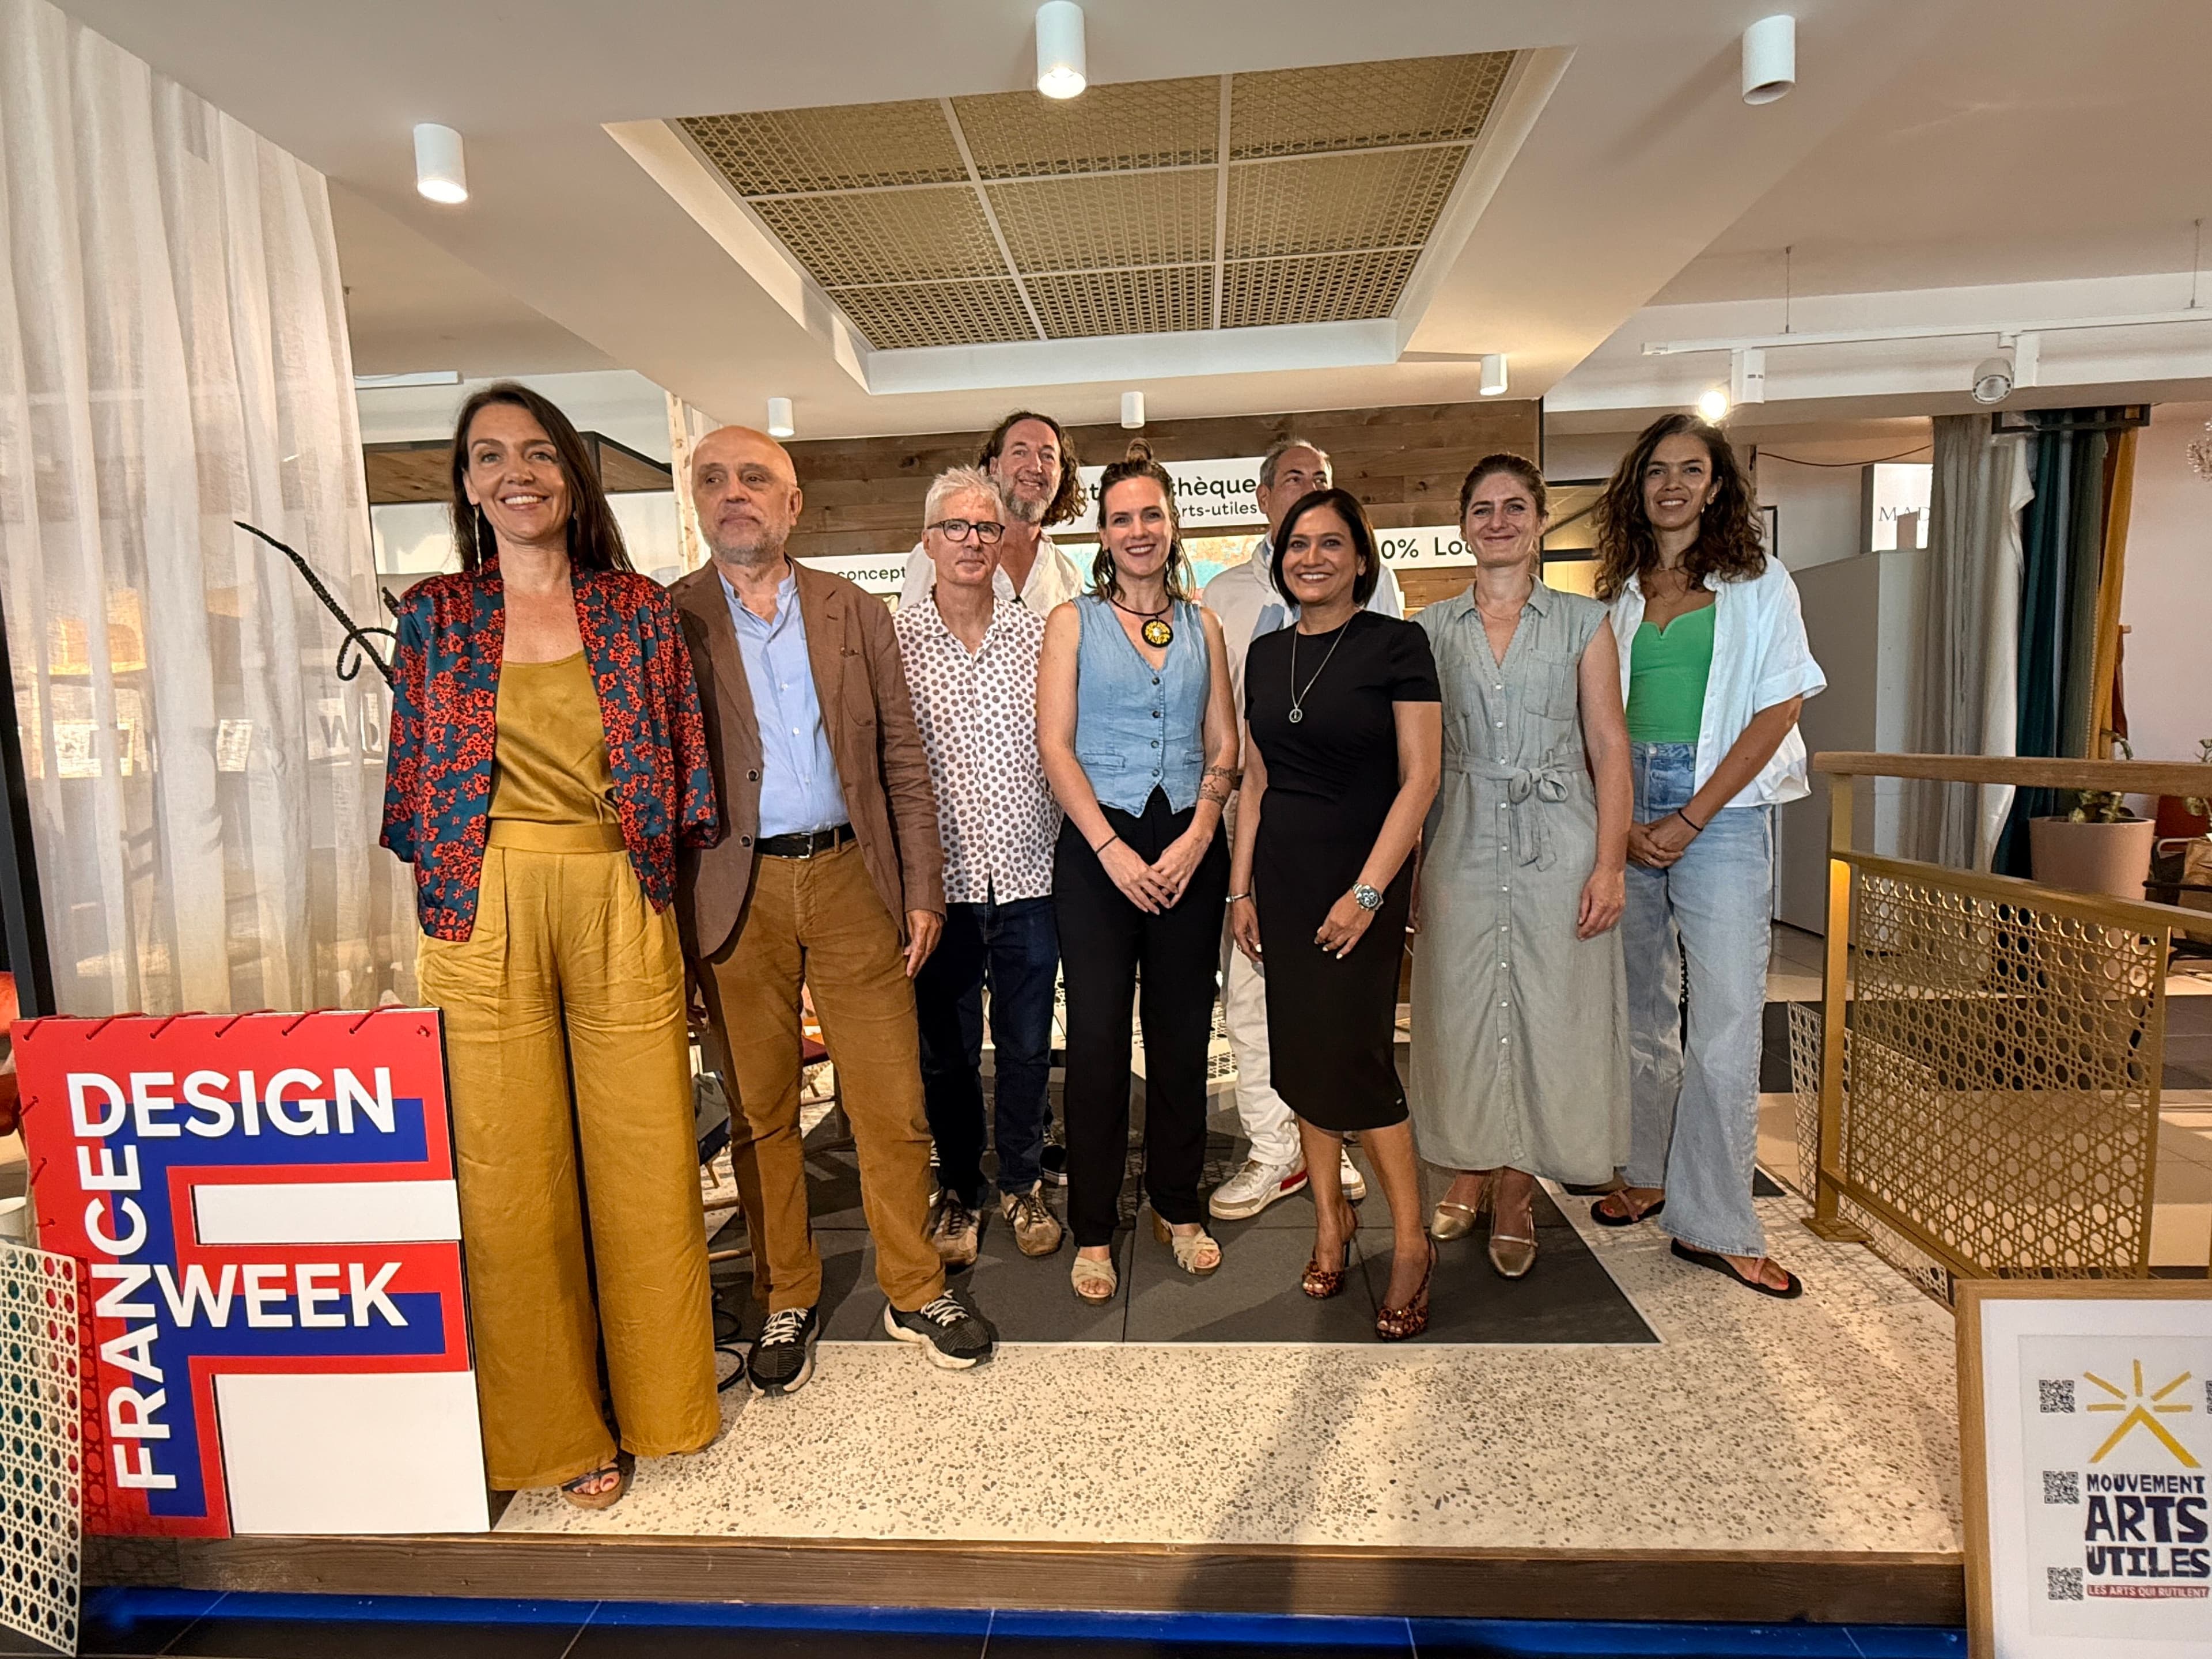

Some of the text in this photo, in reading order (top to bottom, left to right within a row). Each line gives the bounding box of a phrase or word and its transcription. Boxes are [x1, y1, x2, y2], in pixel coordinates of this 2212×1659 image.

[1172, 476, 1256, 499] hèque
[66, 1067, 395, 1137] DESIGN
[153, 1262, 408, 1327] WEEK
[76, 1145, 177, 1489] FRANCE
[2086, 1474, 2205, 1493] MOUVEMENT
[2085, 1495, 2208, 1543] ARTS
[2085, 1546, 2211, 1578] UTILES
[2088, 1585, 2207, 1597] LES ARTS QUI RUTILENT
